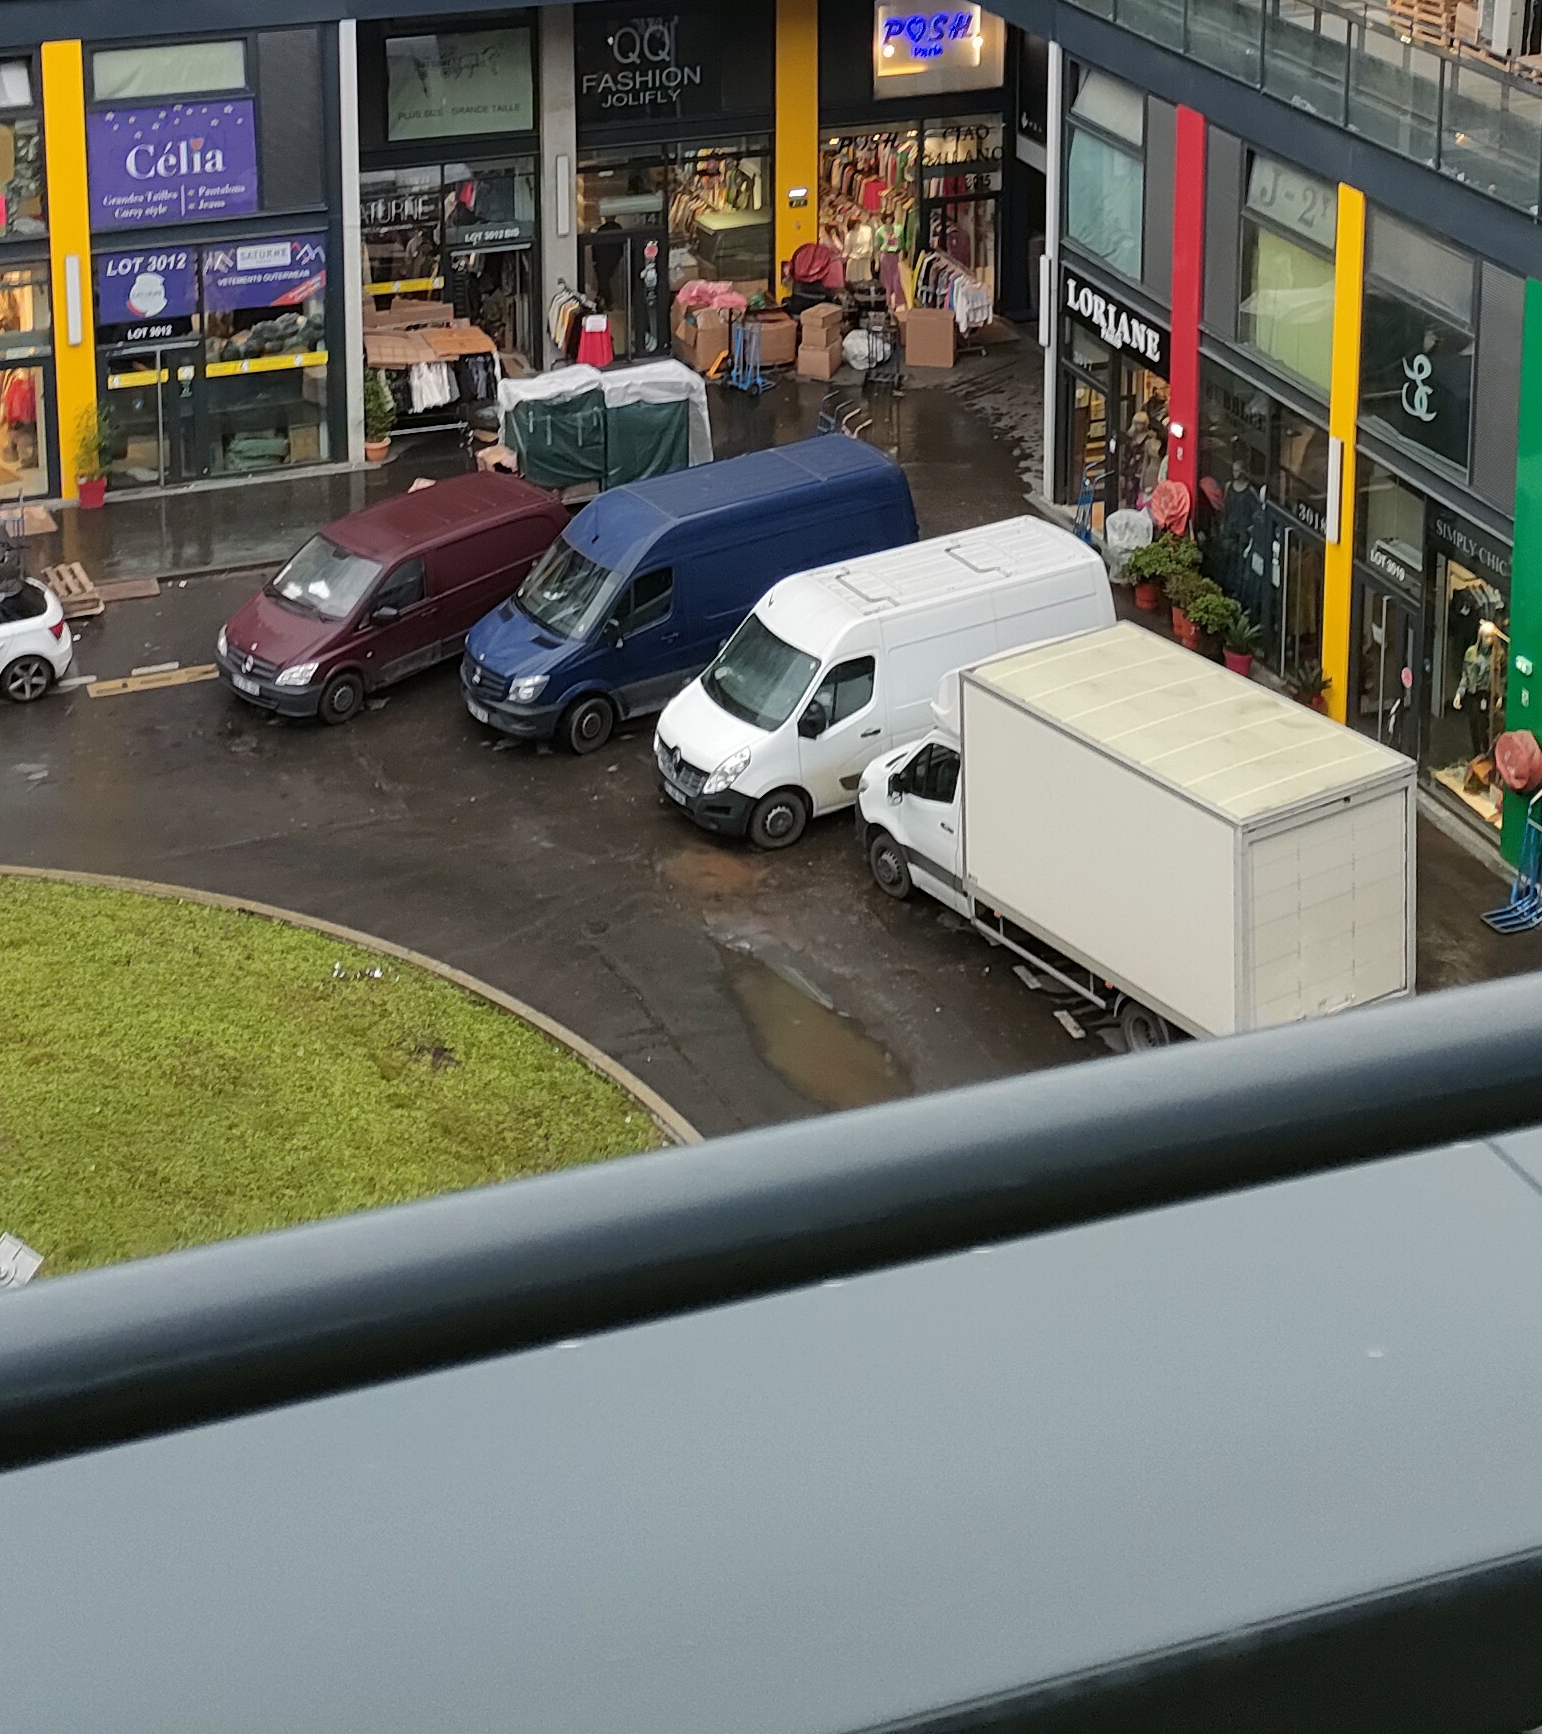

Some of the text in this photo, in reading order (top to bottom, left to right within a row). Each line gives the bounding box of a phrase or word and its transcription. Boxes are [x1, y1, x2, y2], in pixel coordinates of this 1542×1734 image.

[612, 25, 673, 65] QQ
[582, 65, 702, 94] FASHION
[451, 104, 490, 116] GRANDE
[492, 102, 521, 114] TAILLE
[601, 87, 682, 108] JOLIFLY
[125, 137, 226, 180] Célia
[360, 195, 435, 225] ATURNE
[465, 233, 482, 246] LOT
[106, 252, 187, 277] LOT 3012
[1067, 278, 1161, 363] LORIANE
[127, 328, 148, 341] LOT
[1370, 548, 1386, 568] LOT
[1436, 518, 1509, 577] SIMPLY CHIC
